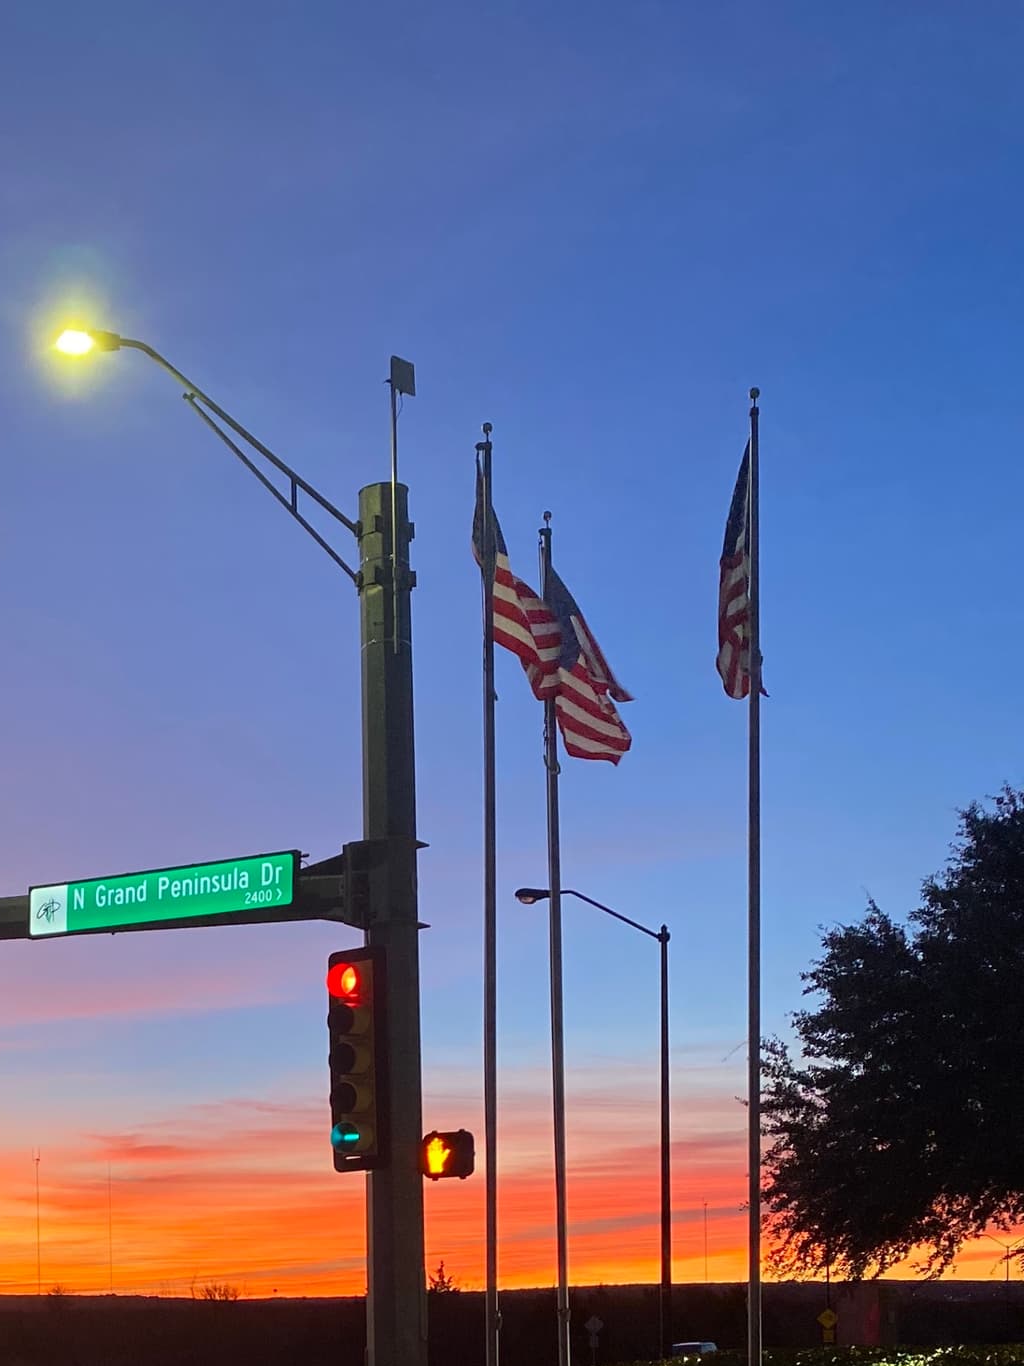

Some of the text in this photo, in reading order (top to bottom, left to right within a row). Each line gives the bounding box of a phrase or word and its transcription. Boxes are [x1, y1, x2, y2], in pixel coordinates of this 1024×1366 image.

[73, 862, 283, 911] N Grand Peninsula Dr
[244, 890, 272, 905] 2400
